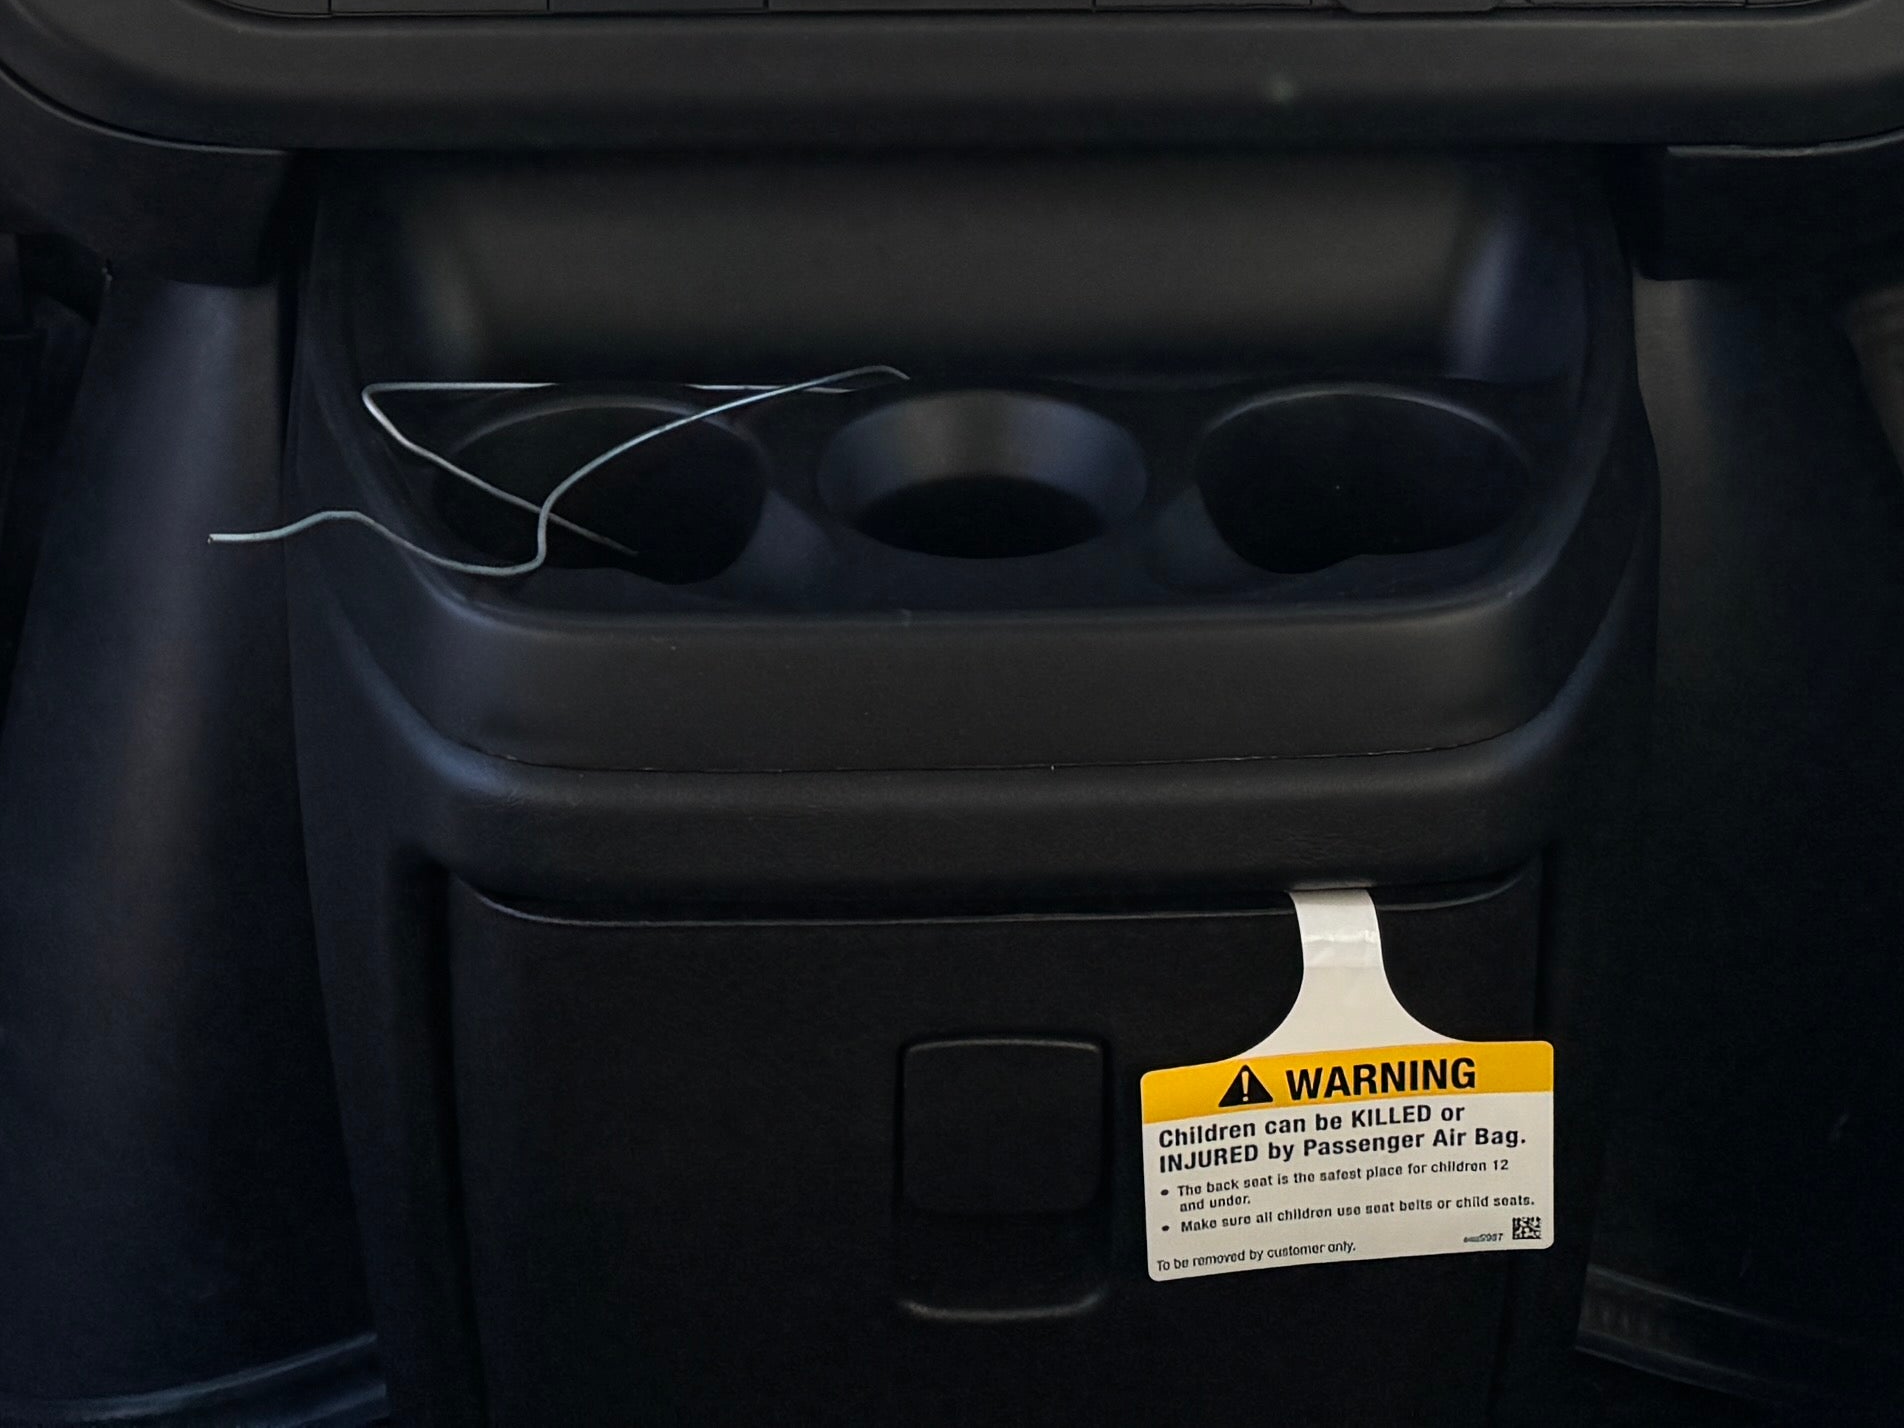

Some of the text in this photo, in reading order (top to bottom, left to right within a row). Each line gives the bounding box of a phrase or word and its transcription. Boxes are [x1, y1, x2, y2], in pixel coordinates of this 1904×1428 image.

[1285, 1057, 1476, 1101] WARNING
[1159, 1104, 1465, 1148] Children can be KILLED or
[1159, 1127, 1525, 1173] INJURED by Passenger Air Bag.
[1177, 1159, 1509, 1197] The back seat is the safest place for children 12
[1180, 1195, 1251, 1212] and under.
[1181, 1195, 1535, 1232] Make sure all children use seat belts or child seats.
[1157, 1240, 1356, 1272] To be removed by customer only.
